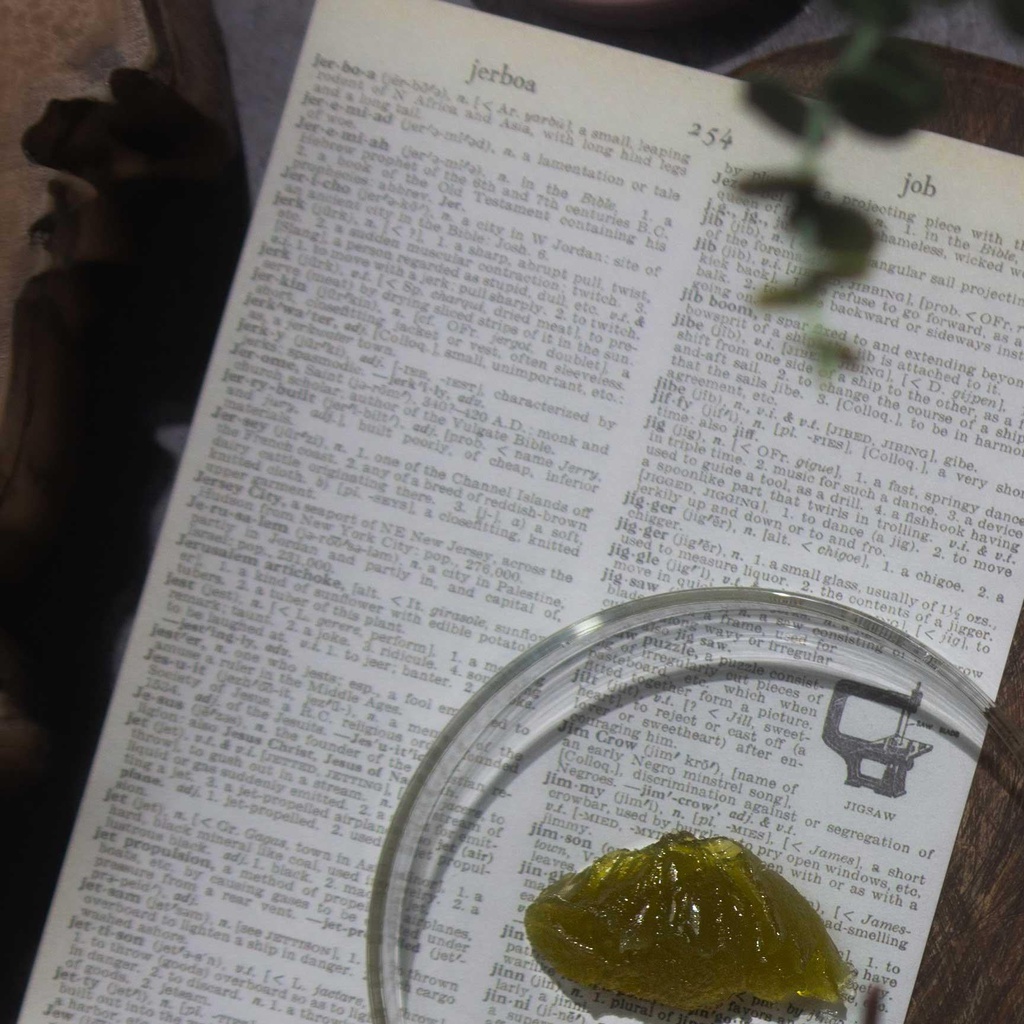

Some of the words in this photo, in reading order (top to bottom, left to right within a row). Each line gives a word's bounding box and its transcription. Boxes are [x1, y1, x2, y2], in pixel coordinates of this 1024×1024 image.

[466, 59, 537, 94] jerboa
[688, 122, 733, 151] 254
[899, 175, 937, 199] job
[680, 287, 705, 304] jib
[708, 294, 758, 321] boom,
[776, 315, 809, 331] spar
[872, 341, 901, 355] and
[903, 349, 976, 378] extending
[669, 355, 702, 372] that
[705, 364, 732, 380] the
[734, 374, 769, 390] sails
[645, 446, 679, 462] used
[700, 461, 742, 478] guide
[759, 474, 790, 495] tool,
[828, 491, 863, 511] drill.
[904, 510, 967, 537] fishhook
[969, 528, 1021, 555] having
[620, 536, 653, 551] used
[677, 551, 738, 573] measure
[742, 564, 788, 587] liquor.
[819, 586, 844, 601] the
[847, 595, 911, 618] contents
[948, 618, 993, 640] jigger.
[582, 657, 624, 678] fitted
[630, 671, 692, 696] together
[699, 688, 733, 707] form
[557, 748, 622, 778] [Colloq.],
[631, 767, 737, 806] discrimination
[743, 801, 798, 822] against
[825, 823, 911, 852] segregation
[586, 745, 623, 765] early
[631, 754, 676, 776] Negro
[682, 771, 743, 793] minstrel
[748, 788, 790, 809] song],
[843, 800, 897, 822] JIGSAW
